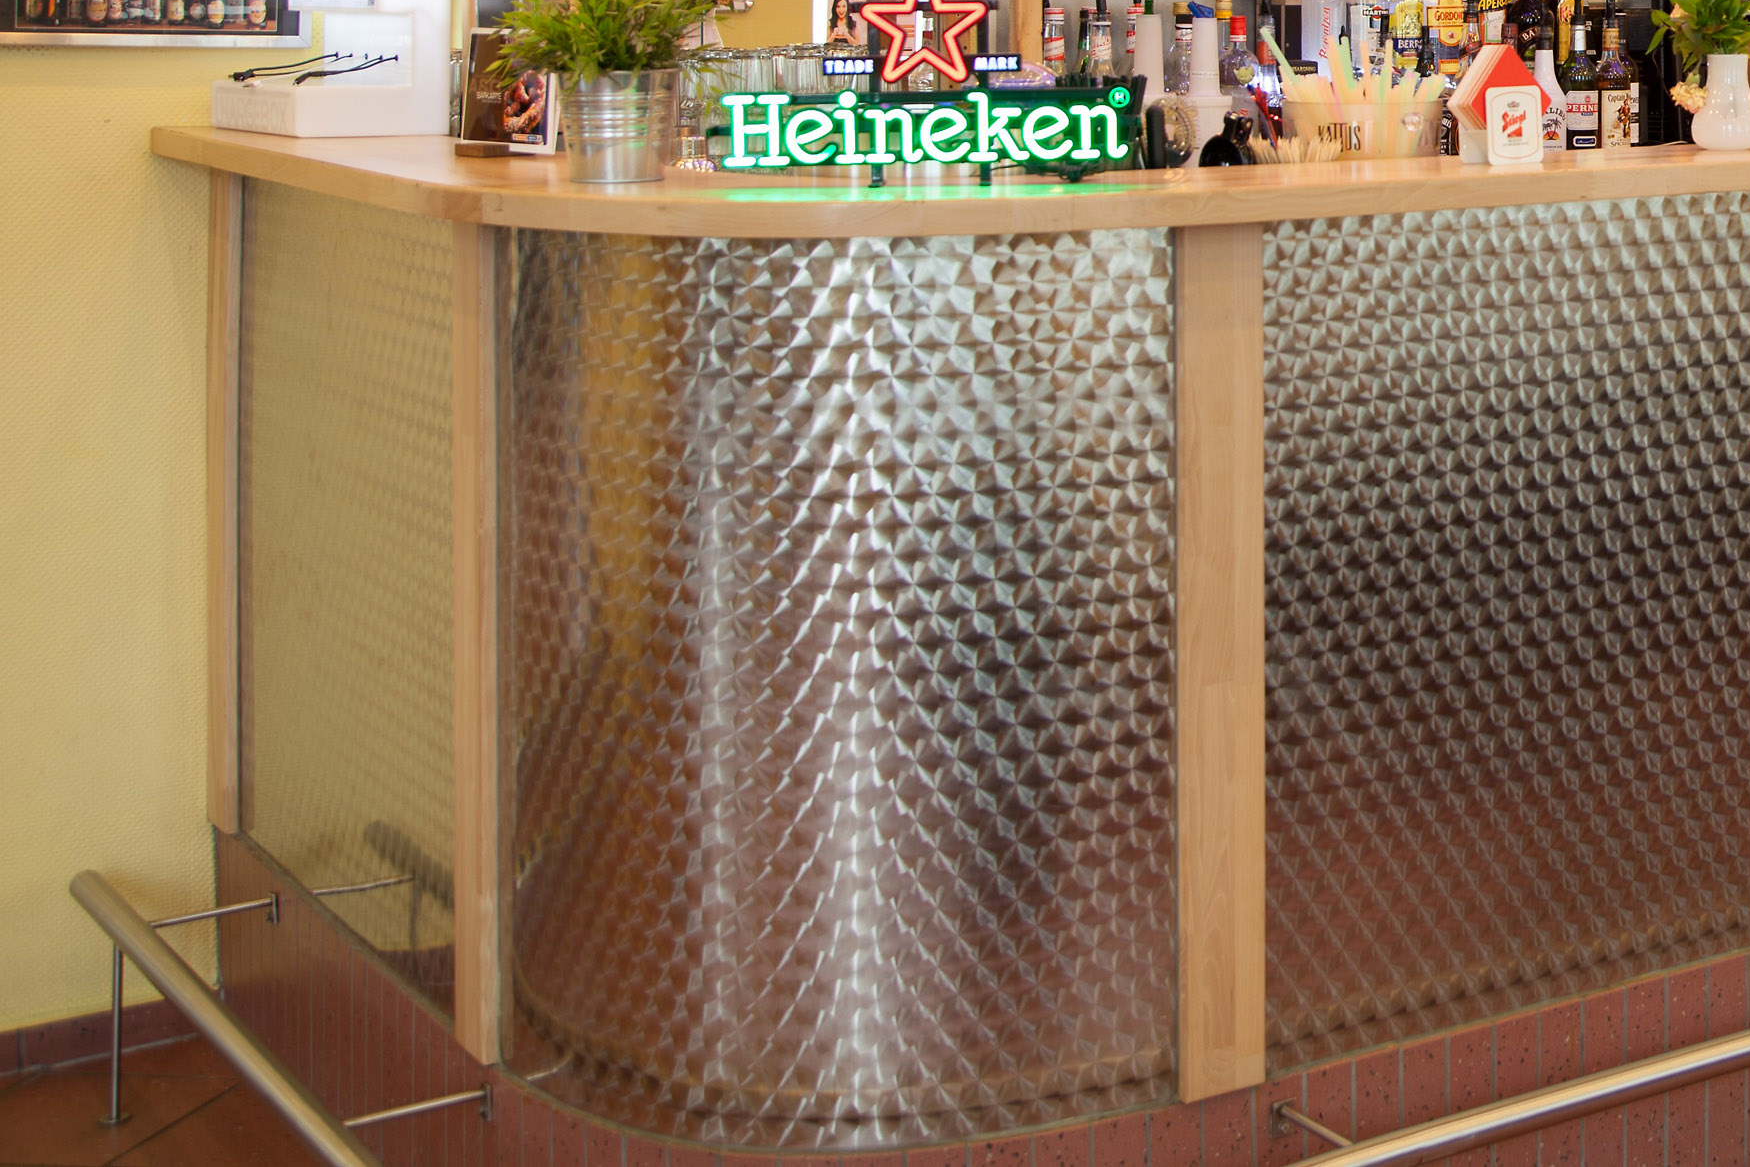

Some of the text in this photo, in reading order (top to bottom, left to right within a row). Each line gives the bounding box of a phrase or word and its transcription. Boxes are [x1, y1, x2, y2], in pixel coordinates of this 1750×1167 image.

[824, 56, 1018, 74] TRADE MARK
[1501, 110, 1527, 127] Stiegl
[720, 90, 1130, 168] Heineken
